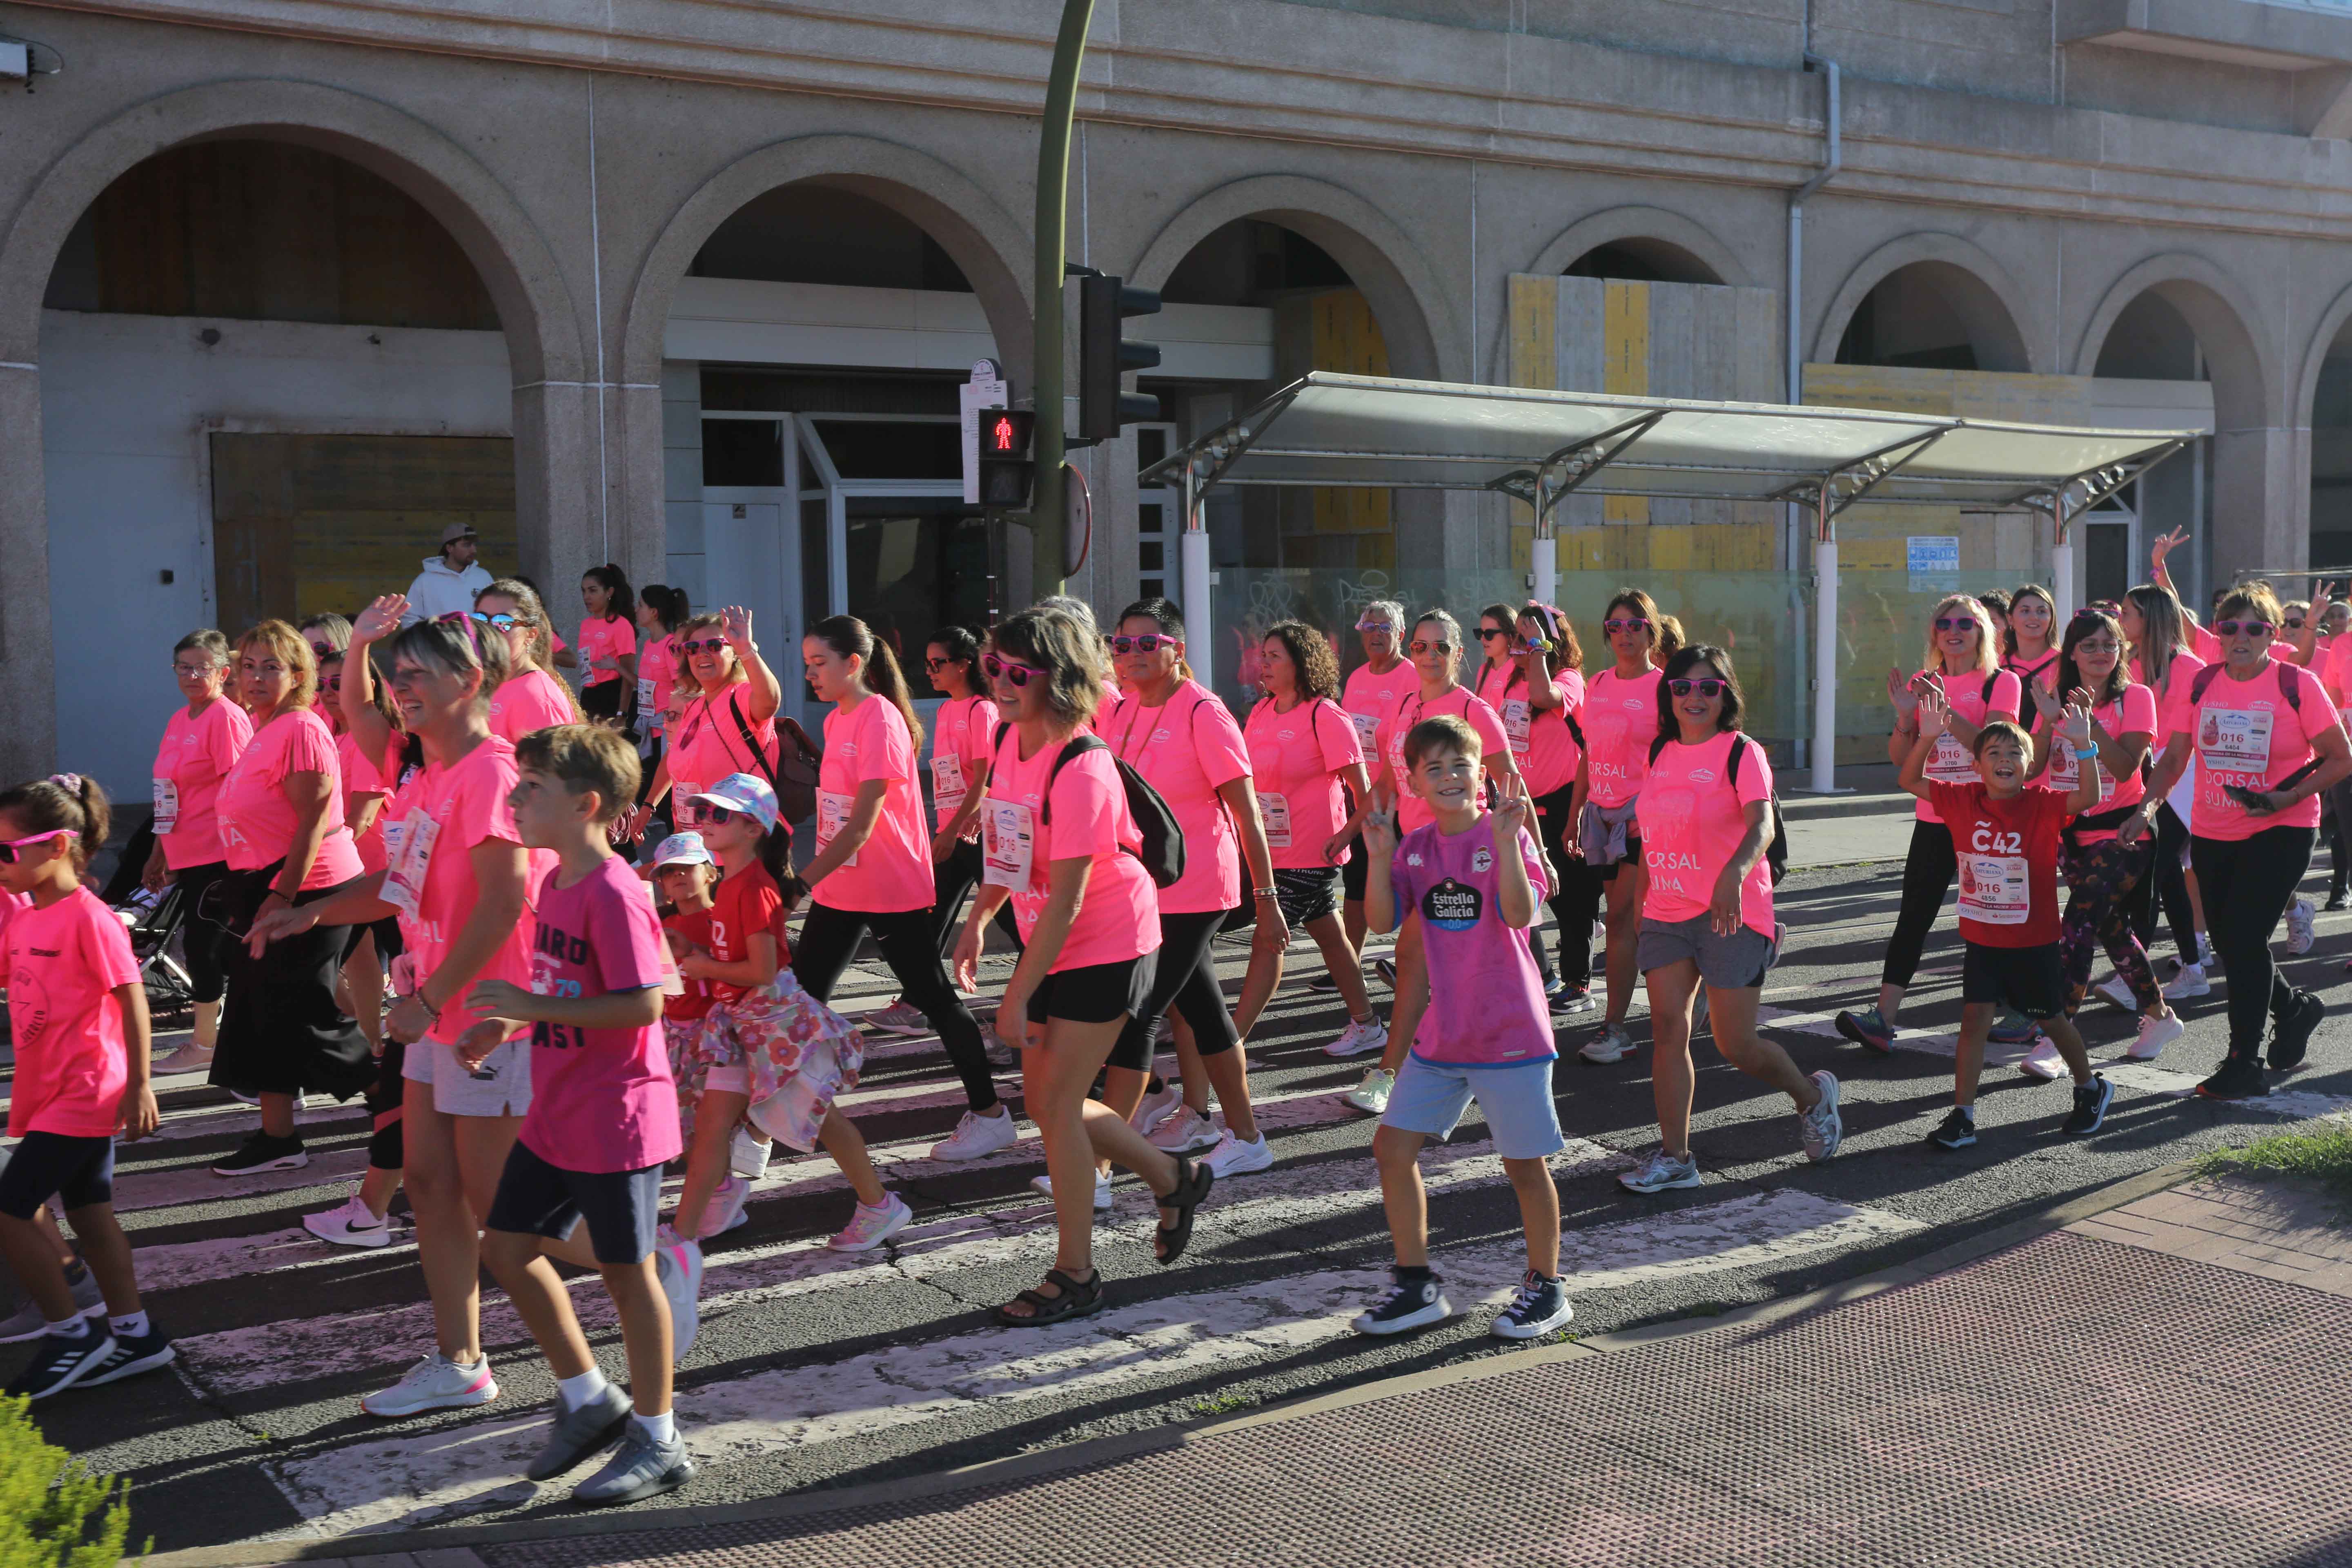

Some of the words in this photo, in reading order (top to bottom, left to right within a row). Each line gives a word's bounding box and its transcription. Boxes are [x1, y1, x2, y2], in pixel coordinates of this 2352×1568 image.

[1505, 719, 1517, 727] 016
[2221, 733, 2244, 743] 016
[1940, 751, 1960, 759] 016
[941, 776, 951, 784] 016
[2205, 771, 2269, 788] DORSAL
[2205, 791, 2242, 808] SUM
[1646, 850, 1702, 870] ORSAL
[1974, 866, 2001, 875] ASTURIANA
[1977, 882, 2000, 893] 016
[1432, 893, 1475, 905] Estrella
[1434, 905, 1474, 918] Galicia
[555, 979, 581, 998] 79
